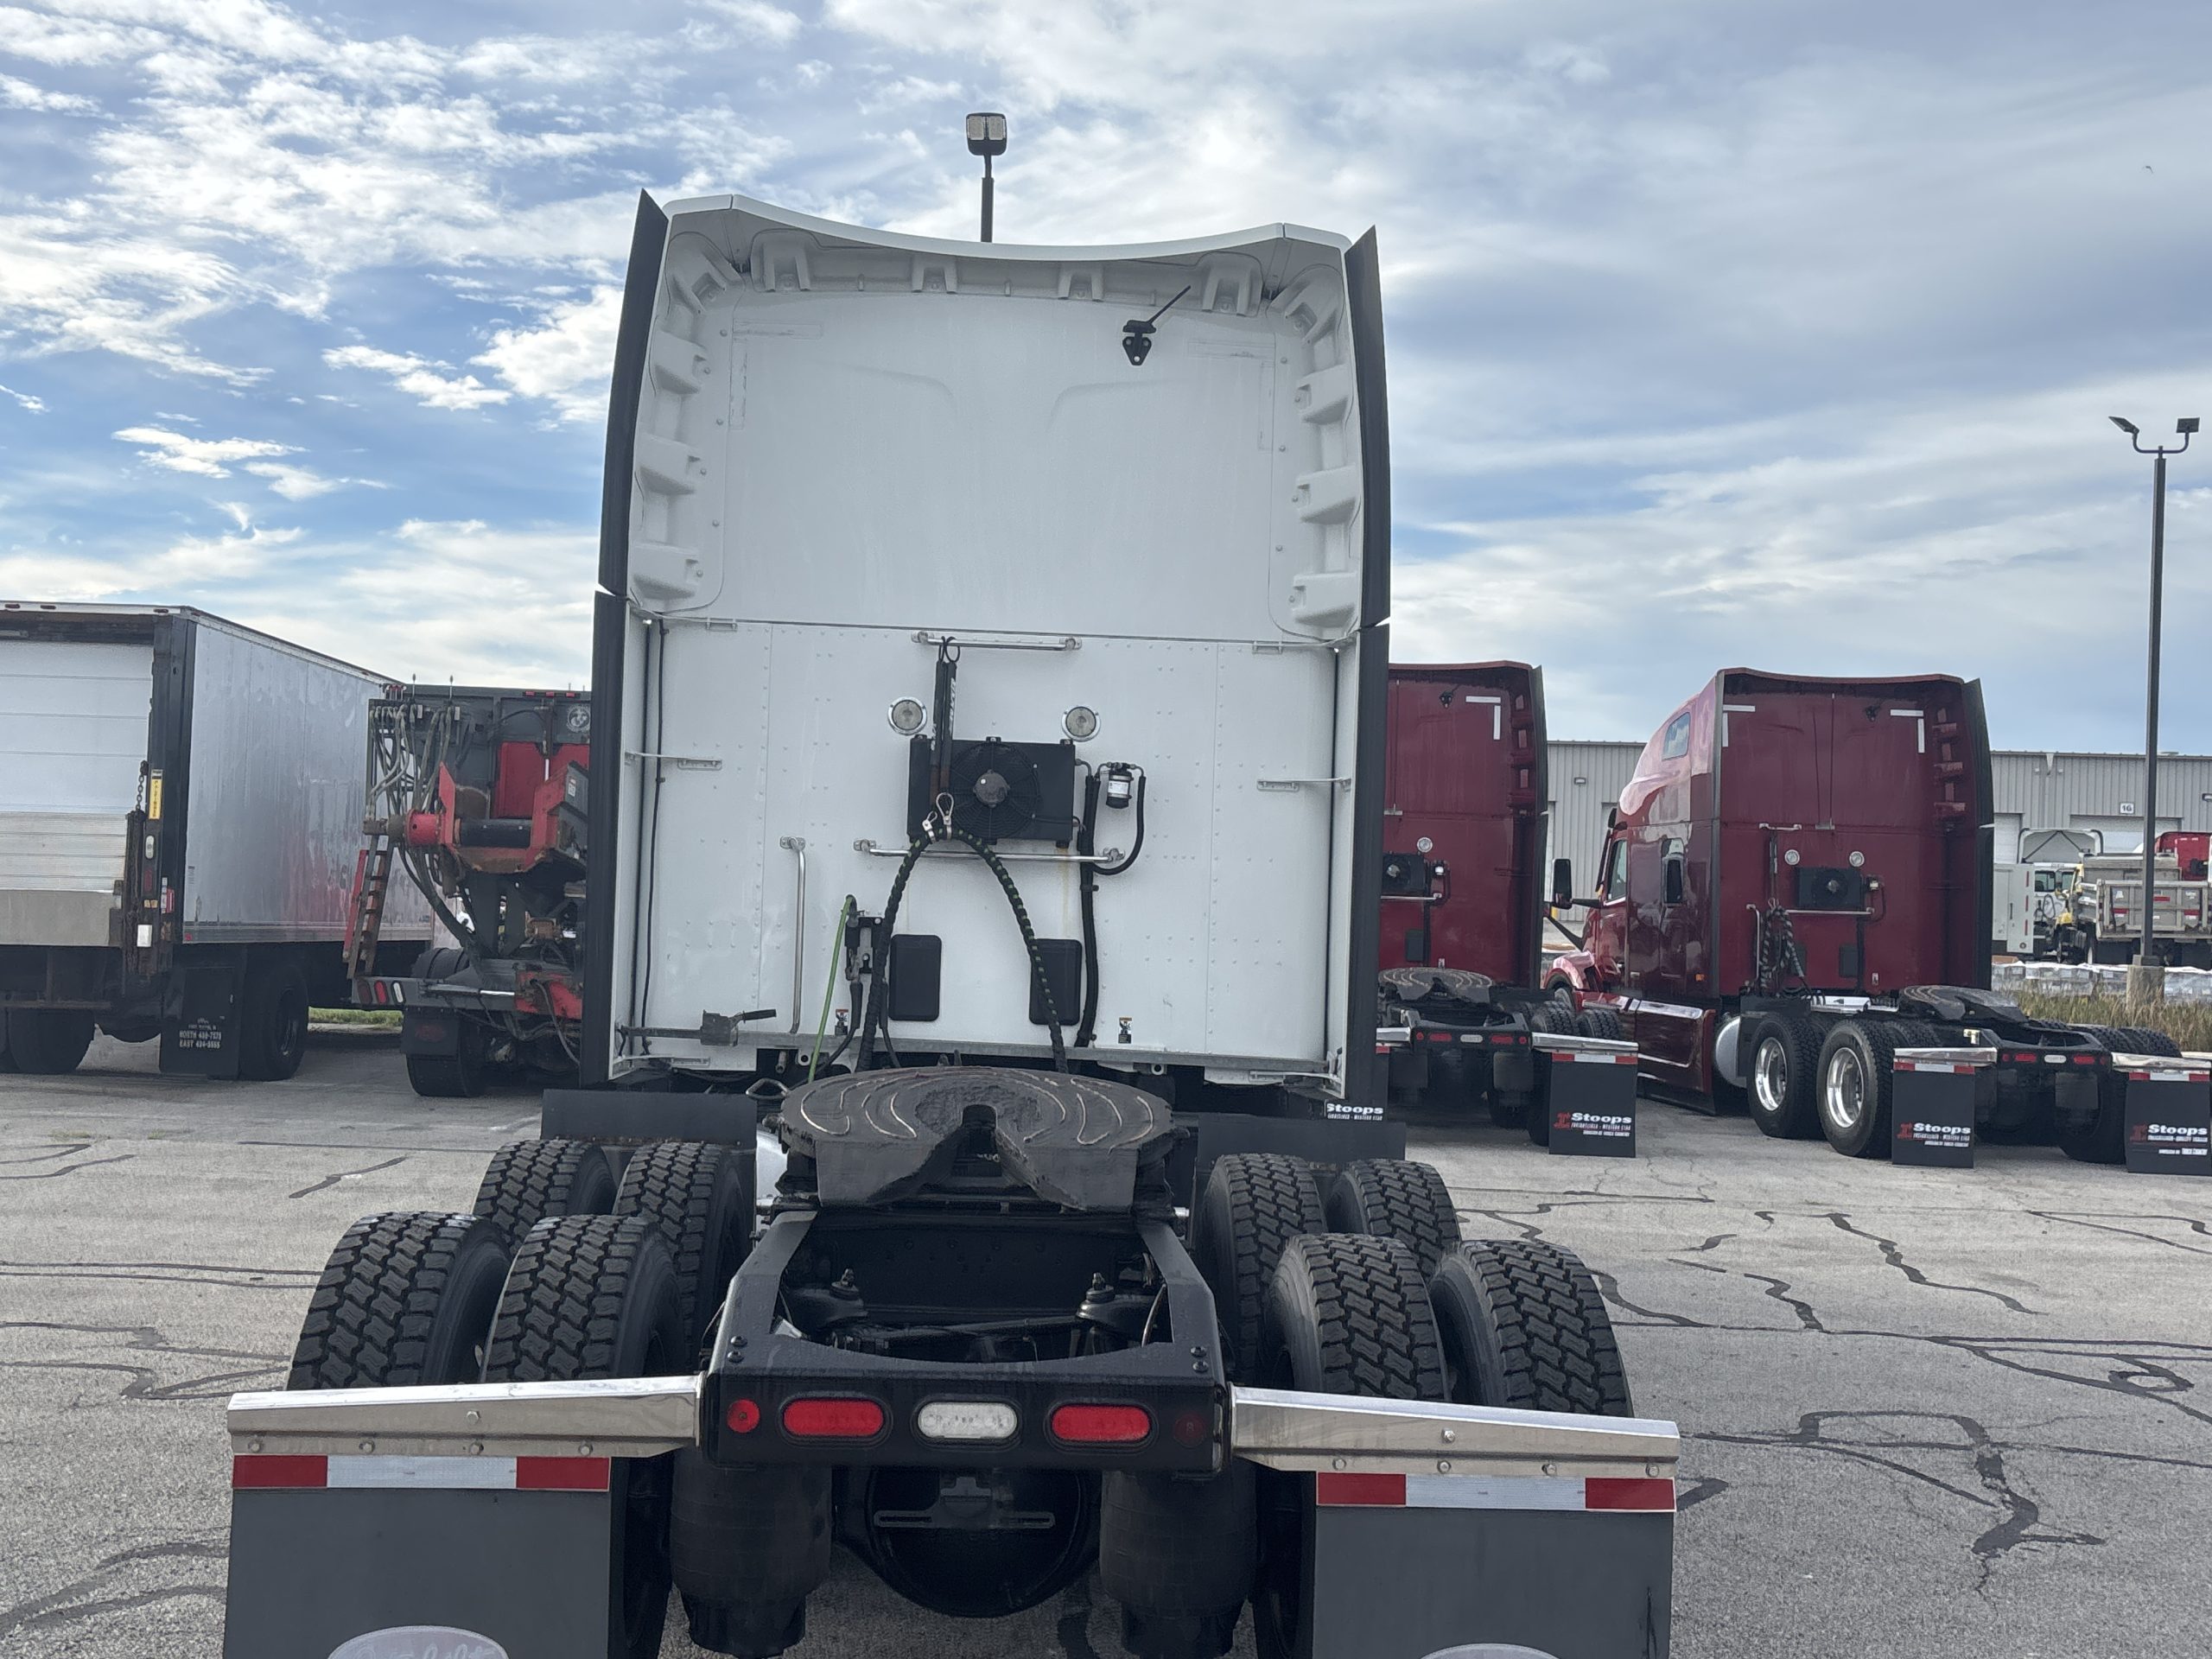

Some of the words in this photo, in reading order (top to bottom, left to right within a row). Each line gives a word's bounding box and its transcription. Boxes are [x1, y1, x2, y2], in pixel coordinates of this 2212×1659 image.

[1326, 1103, 1384, 1116] Stoops
[1571, 1112, 1632, 1125] Stoops
[1913, 1122, 1971, 1135] Stoops
[2147, 1124, 2208, 1136] Stoops
